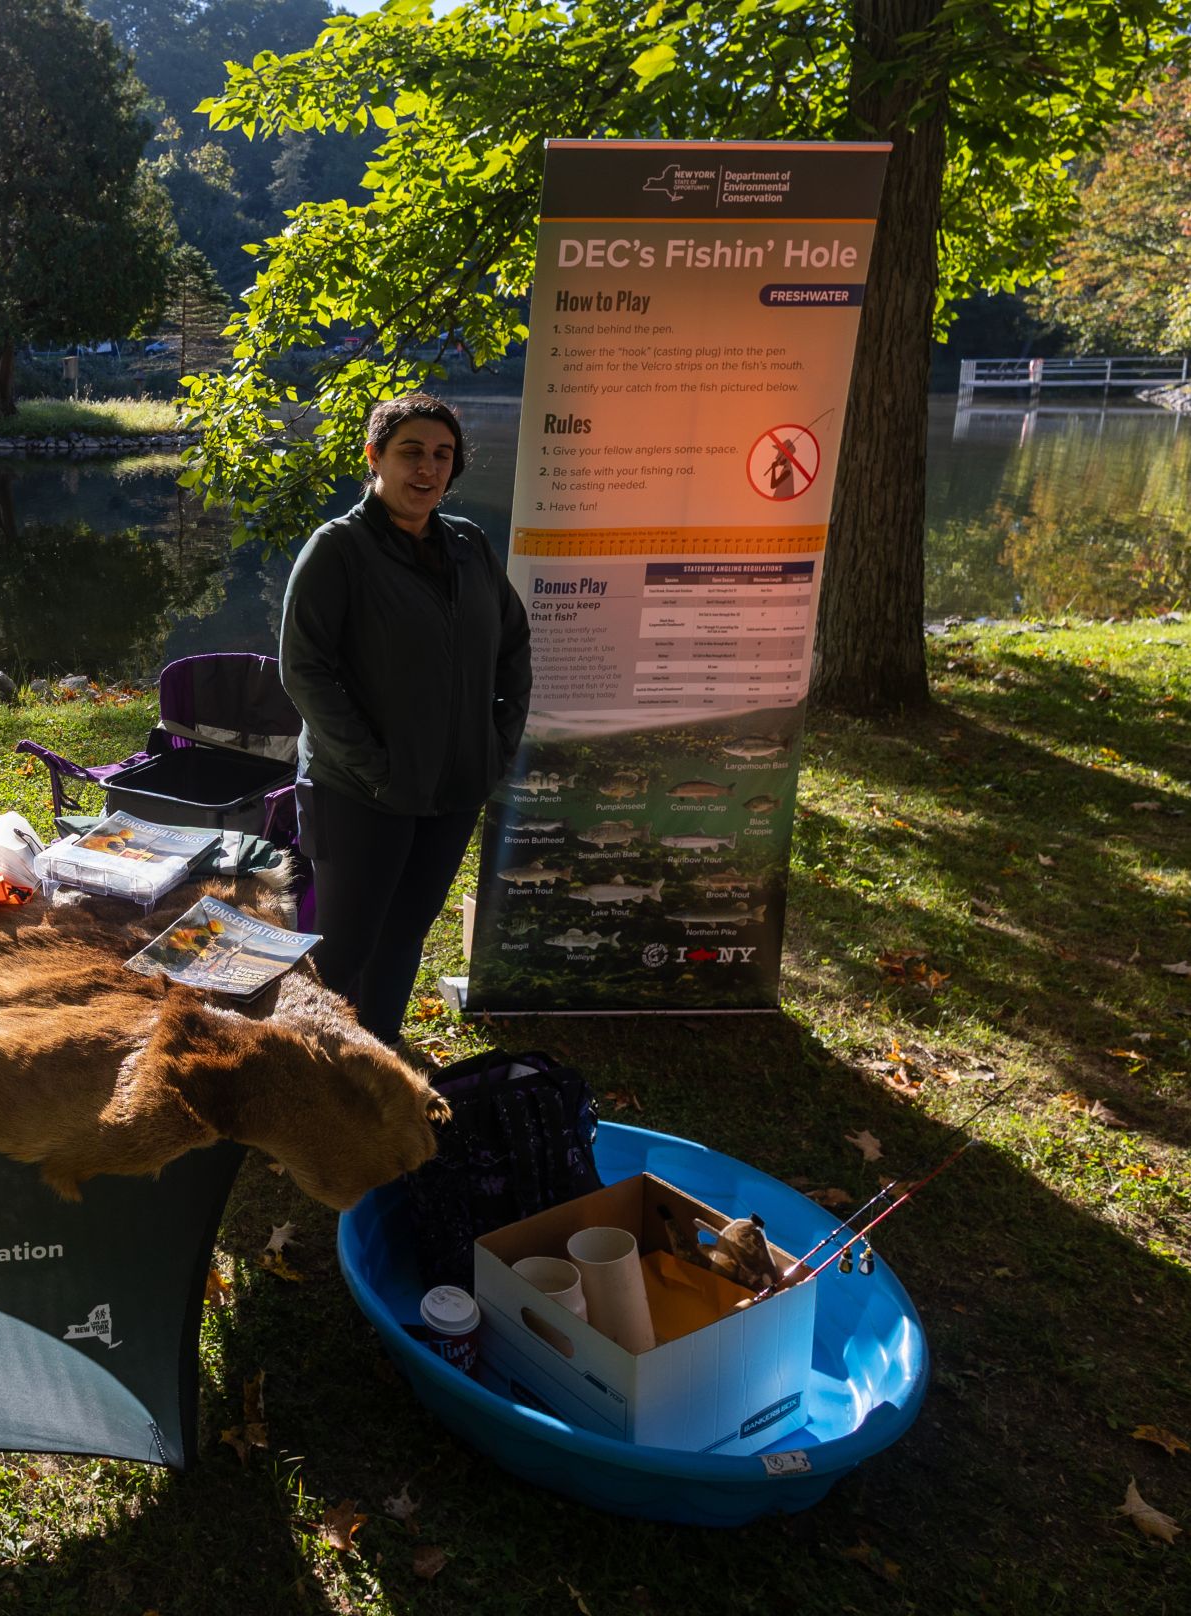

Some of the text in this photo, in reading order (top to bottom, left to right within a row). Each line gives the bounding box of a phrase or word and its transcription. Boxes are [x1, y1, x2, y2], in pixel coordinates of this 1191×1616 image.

[725, 170, 791, 182] Department of
[723, 181, 790, 192] Environmental
[722, 192, 783, 203] Conservation
[558, 239, 857, 268] DEC's Fishin' Hole
[770, 291, 849, 302] FRESHWATER
[555, 290, 651, 315] How to Play
[553, 324, 674, 336] 1. Stand behind the pen.
[551, 346, 786, 358] 2. Lower the "hook" (casting plug) into the pen
[563, 360, 805, 372] and aim for the Velcro strips on the fish's mouth.
[547, 382, 801, 395] 3. Identify your catch from the fish pictured below.
[543, 413, 592, 434] Rules
[541, 445, 739, 458] 1. Give your fellow anglers some space.
[539, 465, 696, 478] 2. Be safe with your fishing rod.
[551, 480, 648, 492] No casting needed.
[536, 501, 598, 511] 3. Have fun!
[534, 578, 608, 596] Bonus Play
[532, 601, 601, 611] Can you keep
[531, 612, 578, 621] that fish?
[564, 626, 590, 635] identify
[592, 627, 608, 635] your
[578, 655, 604, 664] Angling
[597, 664, 617, 672] figure
[551, 683, 569, 691] keep
[543, 692, 571, 702] actually
[571, 692, 595, 701] fishing
[725, 761, 789, 772] Largemouth Bass
[595, 803, 646, 811] Pumpkinseed
[670, 804, 727, 813] Common Carp
[749, 818, 770, 826] Black
[114, 814, 211, 845] CONSERVATIONIST
[743, 828, 773, 837] Crappie
[504, 836, 530, 844] Brown
[578, 852, 621, 860] Smallmouth
[667, 856, 701, 864] Rainbow
[534, 887, 553, 895] Trout
[611, 908, 629, 916] Trout
[203, 901, 311, 946] CONSERVATIONIST
[686, 928, 737, 936] Northern Pike
[501, 942, 529, 952] Bluegill
[566, 954, 596, 962] Walleye
[675, 947, 688, 963] I
[716, 947, 757, 963] NY
[92, 1324, 110, 1332] YORK
[433, 1340, 471, 1360] Tim
[744, 1398, 797, 1432] BANKERS BOX
